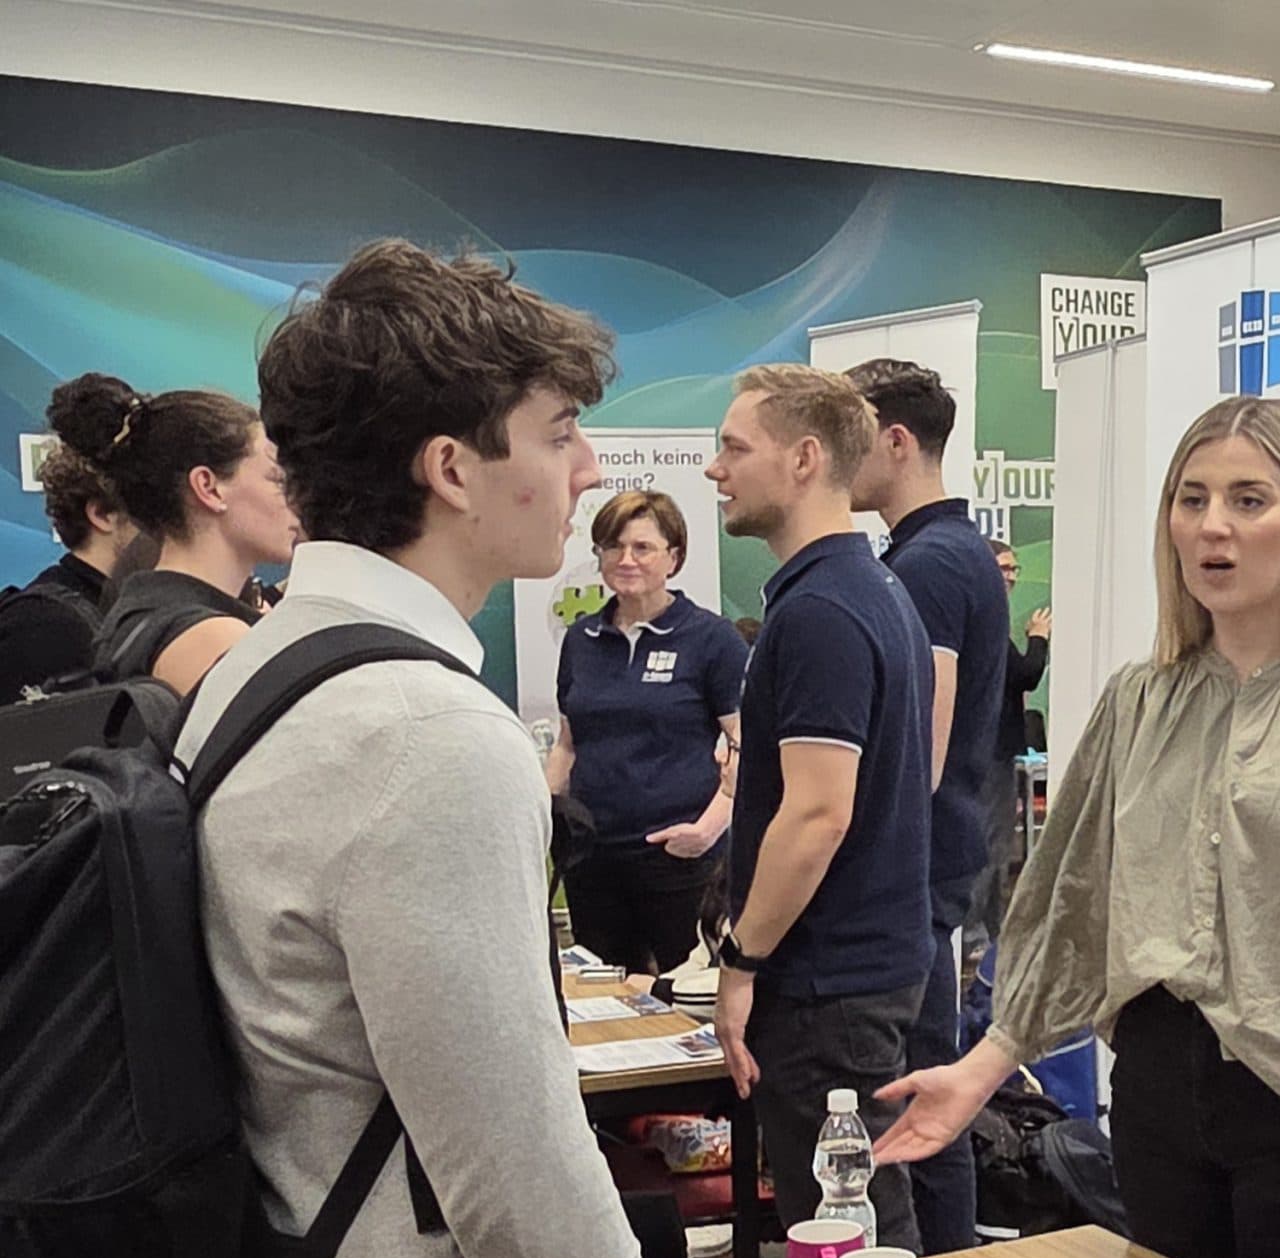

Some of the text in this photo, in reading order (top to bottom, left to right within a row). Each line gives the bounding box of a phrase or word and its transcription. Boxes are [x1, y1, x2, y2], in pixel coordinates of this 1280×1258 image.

[1051, 287, 1136, 317] CHANGE
[598, 449, 704, 466] noch keine
[602, 472, 655, 495] egie?
